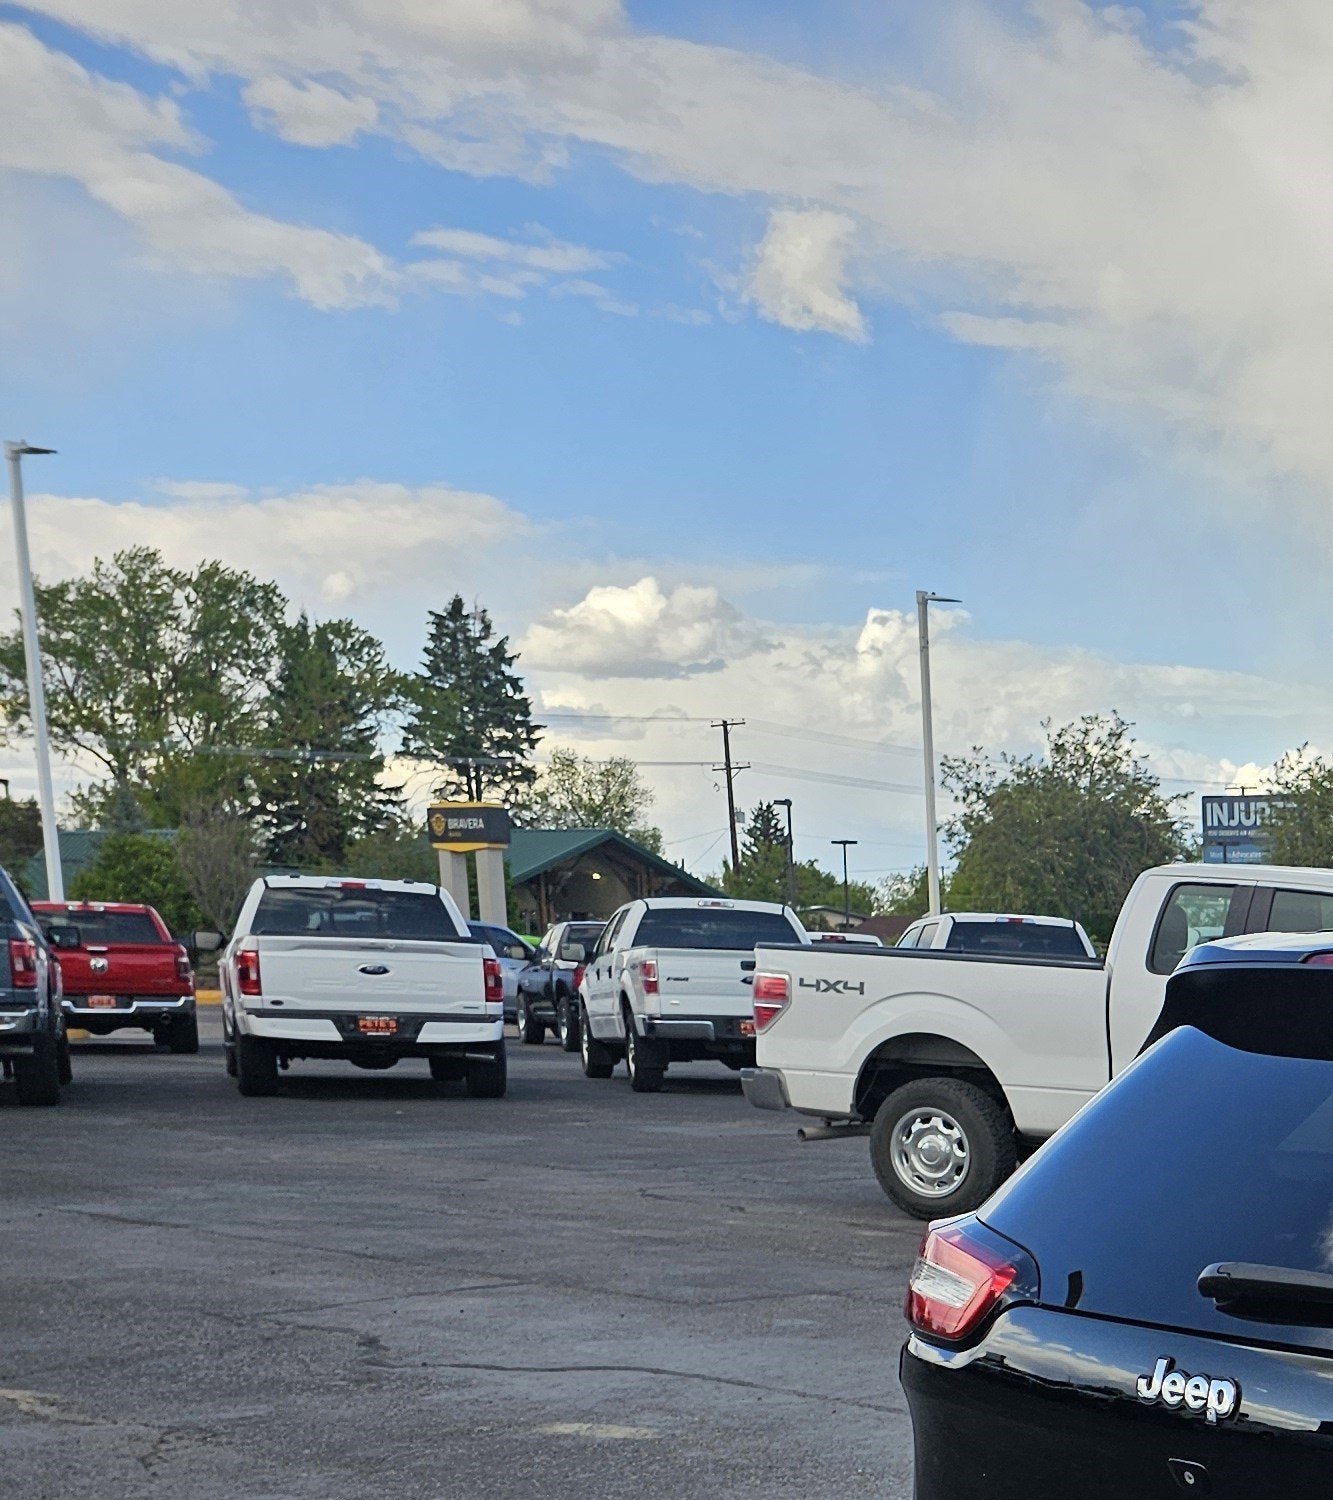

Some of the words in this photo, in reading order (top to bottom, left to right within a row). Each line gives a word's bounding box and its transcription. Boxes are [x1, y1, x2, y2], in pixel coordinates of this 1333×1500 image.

[447, 818, 485, 830] BRAVERA
[799, 977, 865, 996] 4X4
[1137, 1356, 1240, 1425] Jeep
